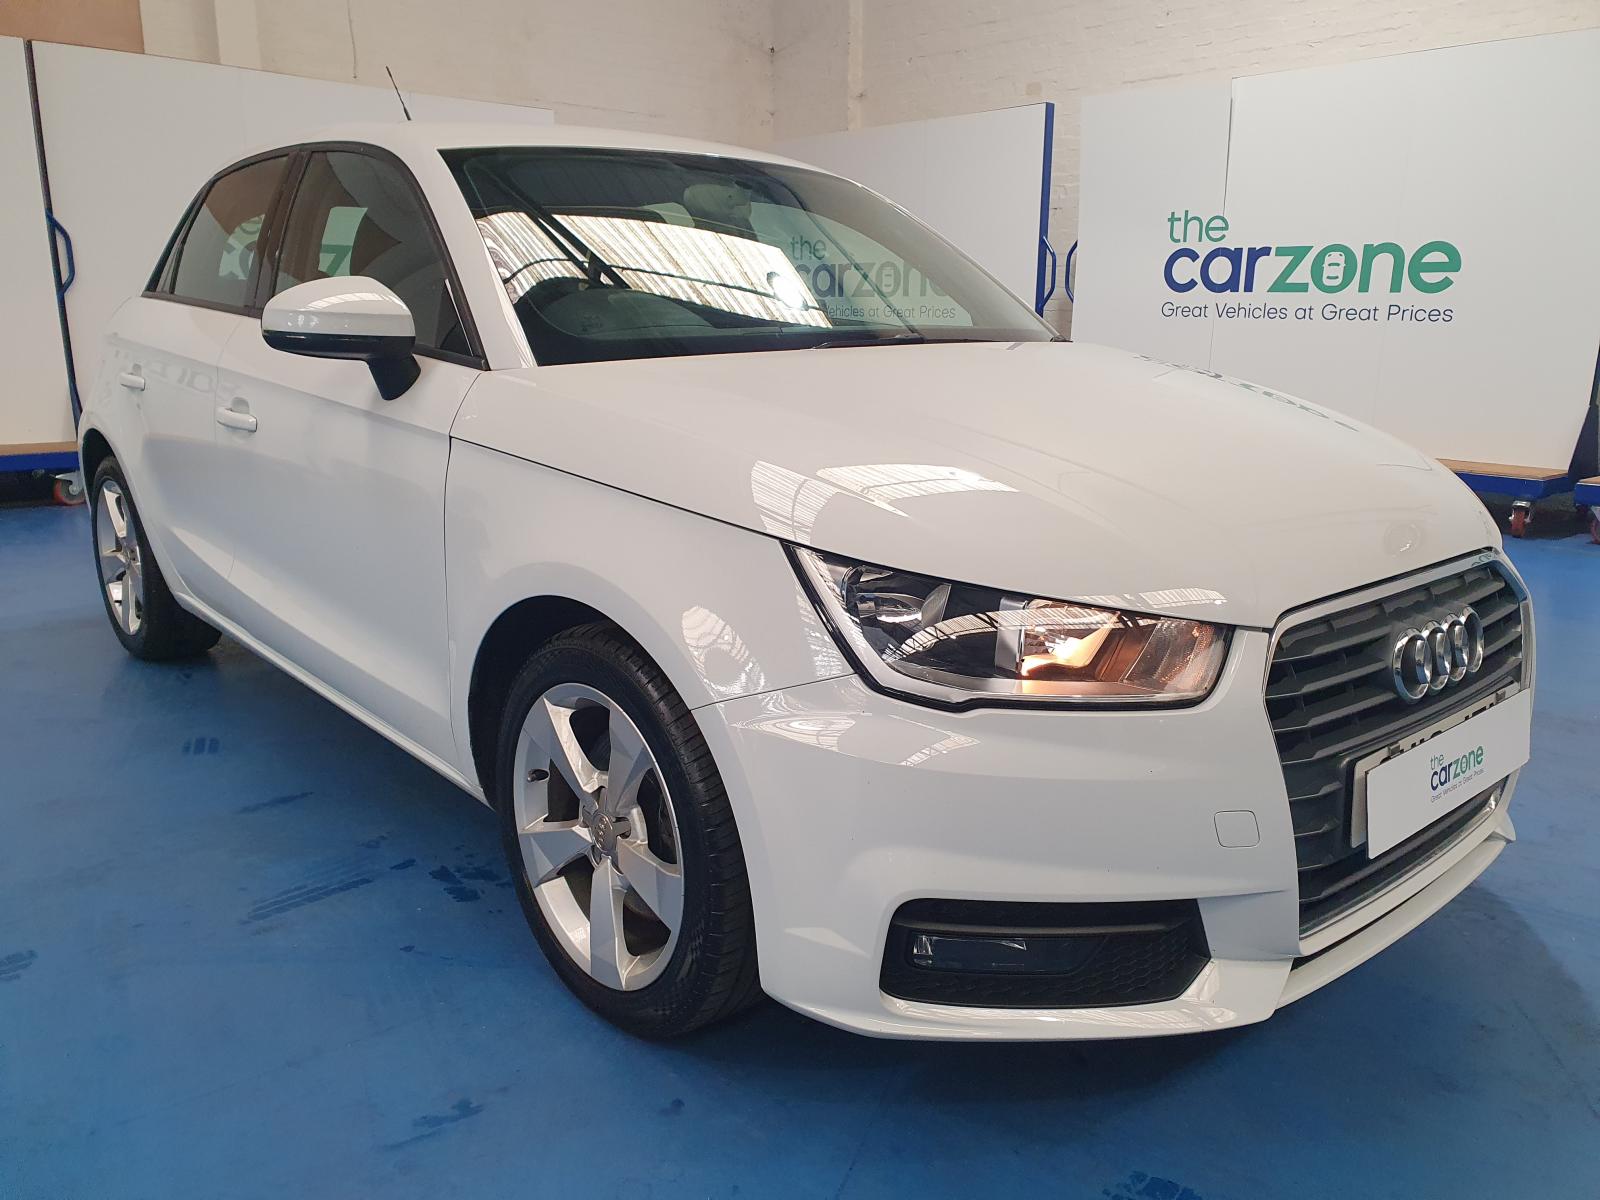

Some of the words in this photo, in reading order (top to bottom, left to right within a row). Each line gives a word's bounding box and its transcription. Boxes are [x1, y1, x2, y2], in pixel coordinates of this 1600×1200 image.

[1167, 209, 1230, 244] the
[790, 235, 827, 261] the
[1163, 240, 1463, 294] carzone
[868, 305, 879, 318] at
[919, 305, 956, 319] Prices
[1160, 301, 1209, 319] Great
[1215, 302, 1288, 321] Vehicles
[1294, 306, 1314, 321] at
[1321, 302, 1379, 322] Great
[1386, 304, 1454, 323] Prices
[1430, 753, 1444, 771] the
[1430, 745, 1484, 791] carzone
